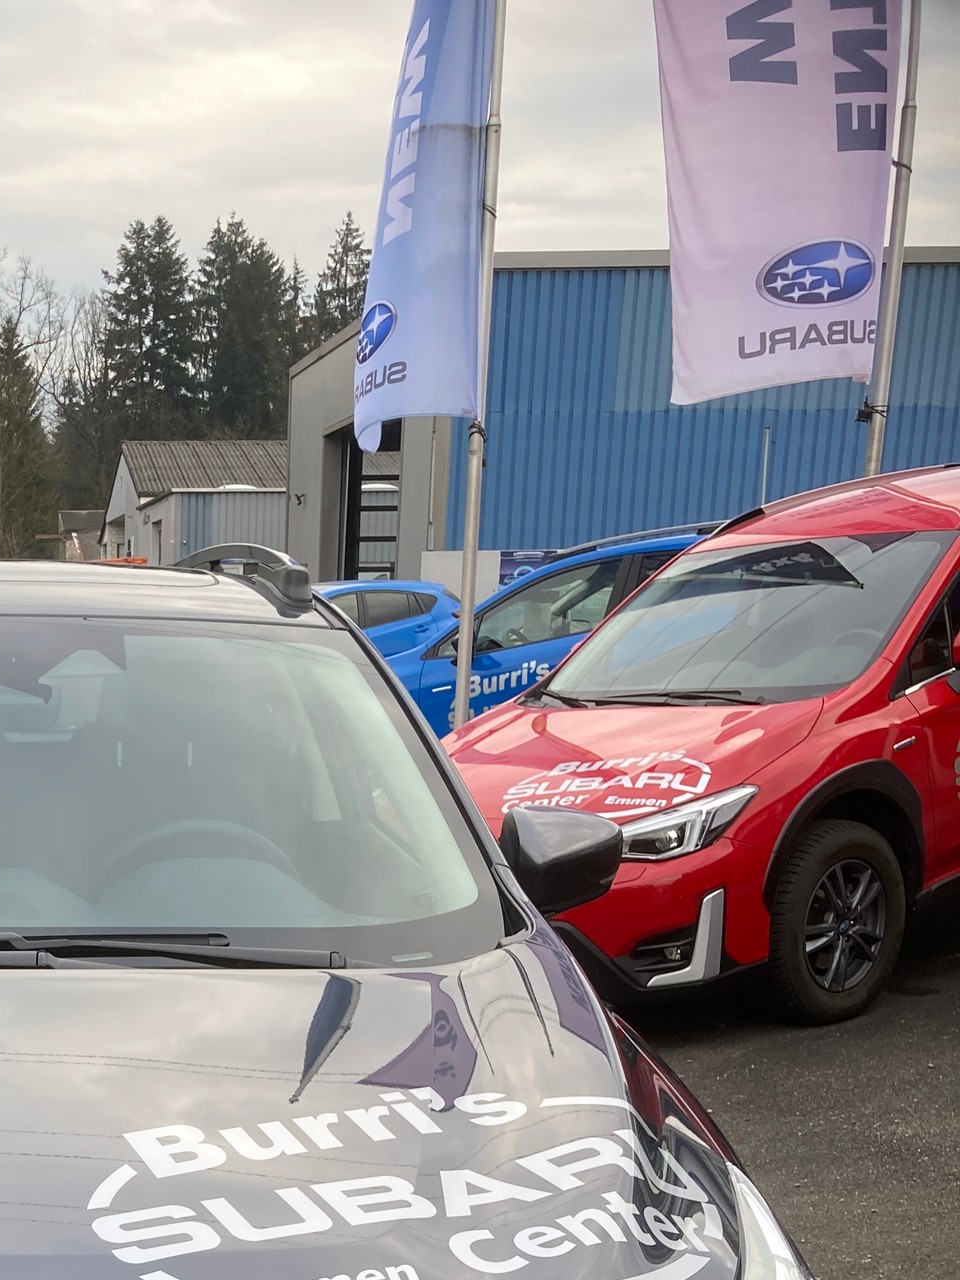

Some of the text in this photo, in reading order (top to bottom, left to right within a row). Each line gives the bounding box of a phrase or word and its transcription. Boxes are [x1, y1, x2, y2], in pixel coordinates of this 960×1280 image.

[468, 659, 550, 699] Burri's
[546, 749, 688, 778] Burri's
[502, 771, 712, 800] SUBARU
[604, 794, 668, 808] Emmen
[122, 1085, 528, 1179] Burri's
[91, 1128, 710, 1265] SUBARU
[447, 1190, 711, 1275] Center
